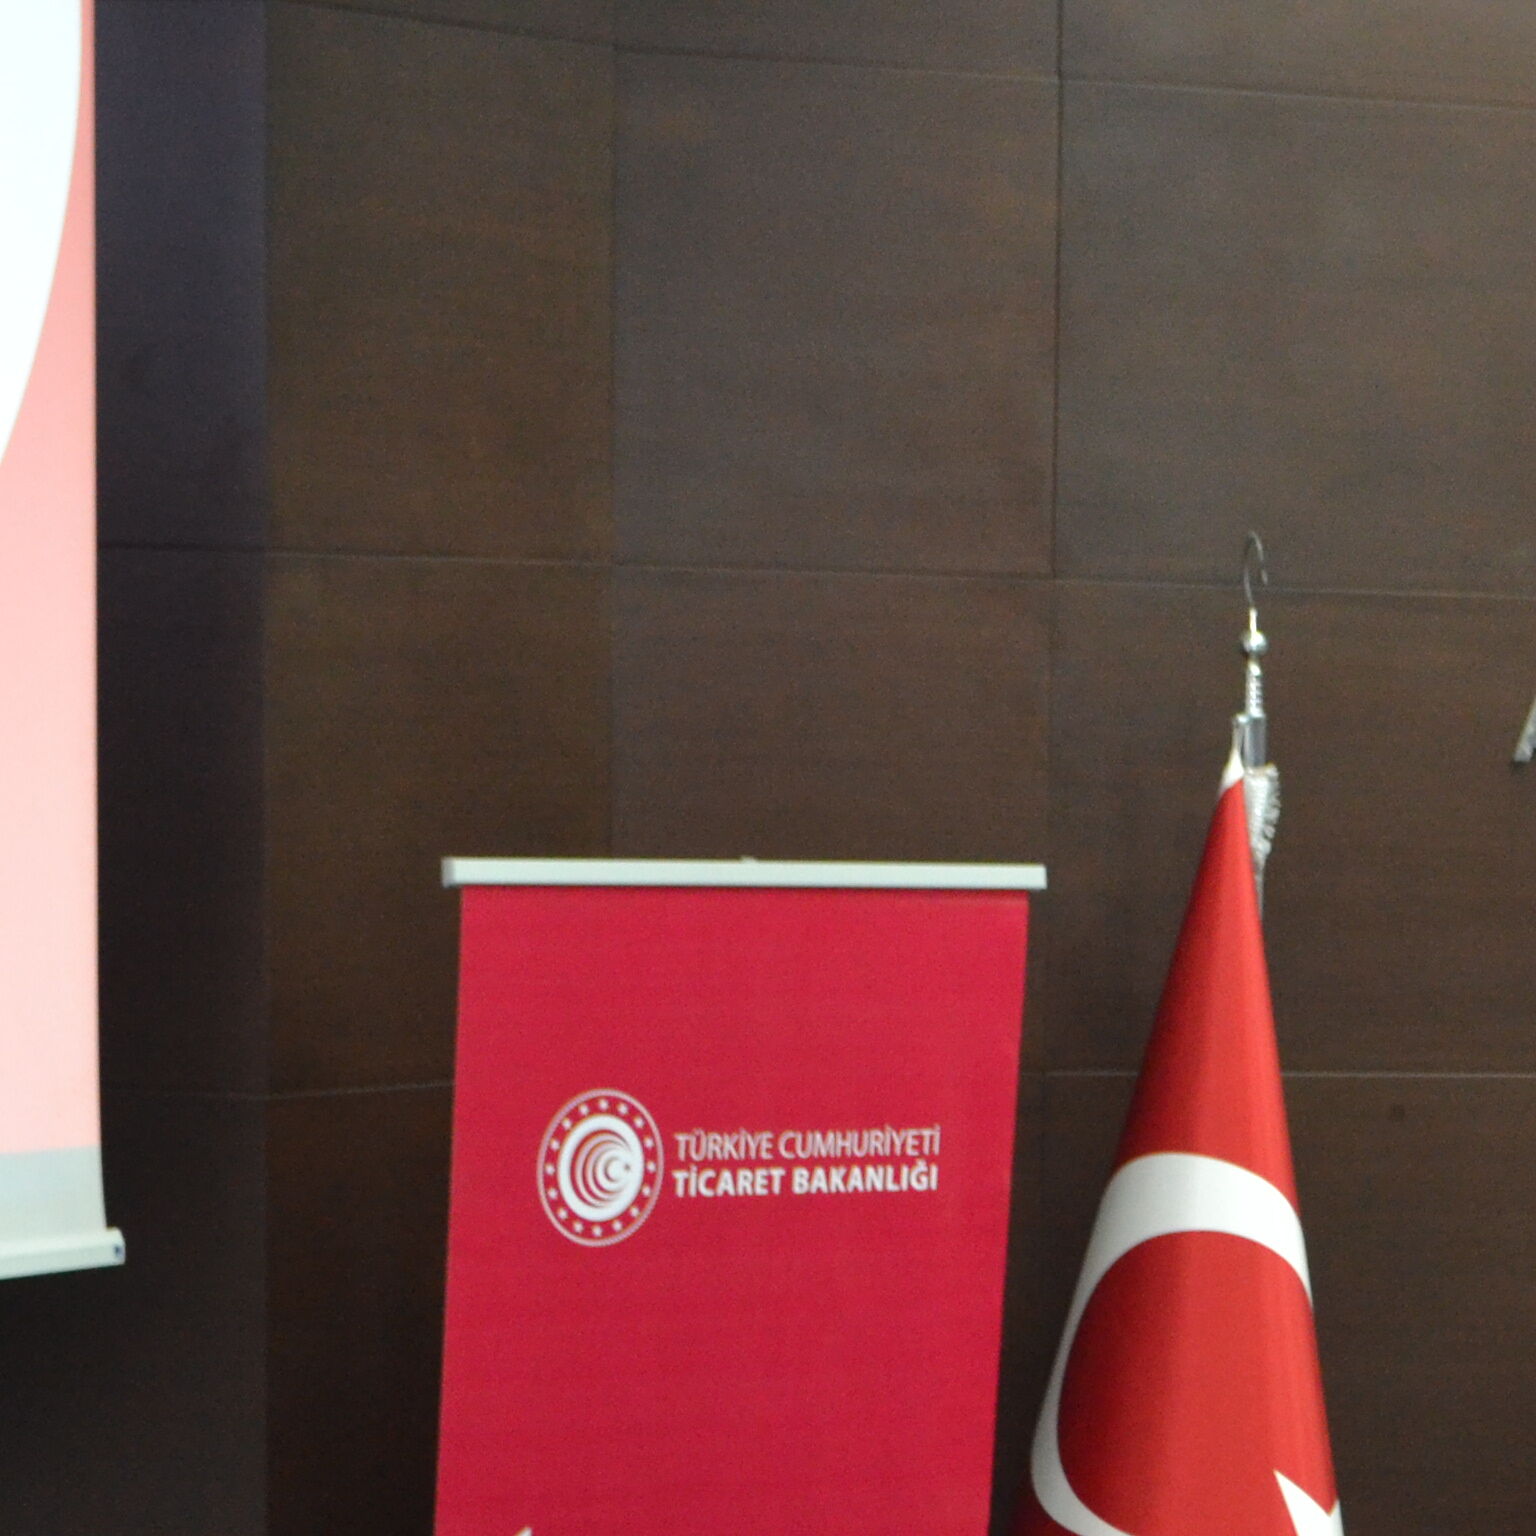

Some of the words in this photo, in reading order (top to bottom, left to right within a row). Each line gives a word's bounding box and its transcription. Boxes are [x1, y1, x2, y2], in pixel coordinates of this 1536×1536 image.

[673, 1128, 775, 1162] TÜRKİYE
[778, 1123, 942, 1160] CUMHURİYETİ
[671, 1163, 786, 1198] TİCARET
[791, 1158, 939, 1195] BAKANLIĞI
